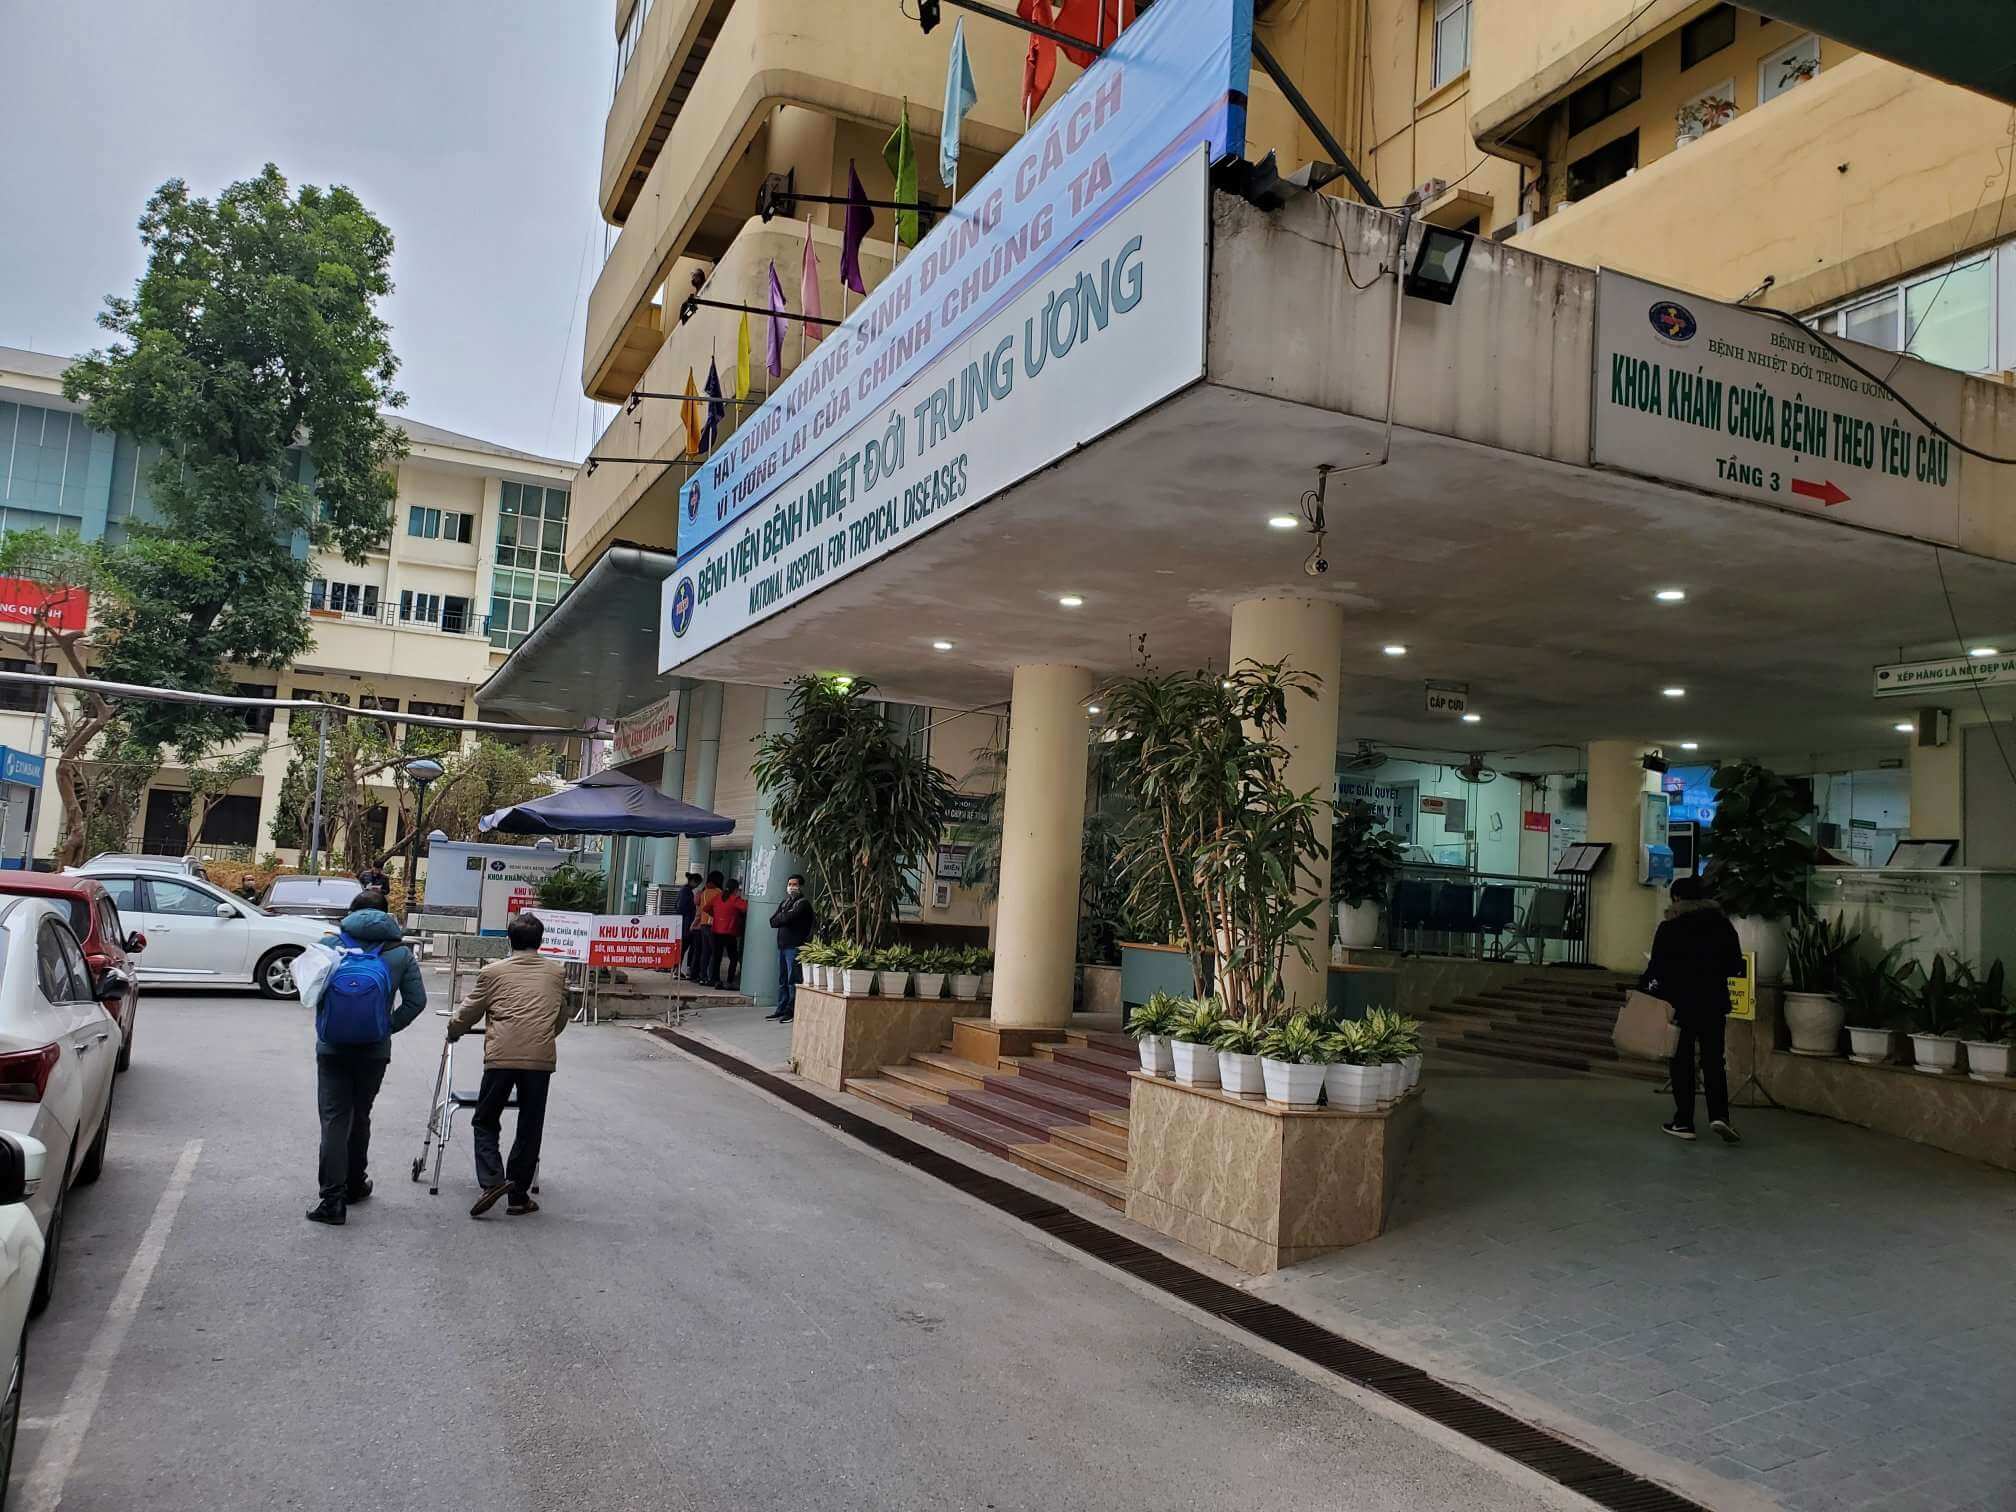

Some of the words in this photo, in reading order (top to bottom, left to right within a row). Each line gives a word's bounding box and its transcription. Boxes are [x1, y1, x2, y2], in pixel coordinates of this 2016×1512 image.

[741, 405, 781, 464] DÙNG
[787, 339, 849, 422] KHÁNG
[856, 276, 912, 355] SINH
[920, 187, 1003, 296] ĐÚNG
[1014, 67, 1124, 204] CÁCH
[718, 489, 729, 521] VÌ
[732, 451, 777, 509] TƯƠNG
[813, 385, 851, 440] CỦA
[858, 311, 932, 401] CHÍNH
[941, 203, 1053, 328] CHÚNG
[1067, 152, 1113, 218] TA
[1816, 368, 1858, 393] TRUNG
[697, 551, 728, 608] BỆNH
[730, 525, 760, 583] VIỆN
[762, 495, 804, 564] BỆNH
[806, 450, 860, 533] NHIỆT
[863, 409, 906, 493] ĐỚI
[914, 334, 1014, 457] TRUNG
[1024, 235, 1143, 379] ƯƠNG
[1612, 353, 1662, 416] KHOA
[1667, 366, 1722, 432] KHÁM
[1727, 381, 1776, 445] CHỮA
[1781, 393, 1827, 463] BỆNH
[1832, 413, 1875, 470] THEO
[1880, 418, 1912, 478] YÊU
[1716, 454, 1763, 488] TẦNG
[1769, 471, 1781, 492] 3
[749, 568, 784, 616] NATIONAL
[786, 542, 825, 594] HOSPITAL
[827, 530, 846, 572] FOR
[848, 496, 899, 559] TROPICAL
[903, 453, 967, 529] DISEASES
[1916, 668, 1943, 680] HÀNG
[1945, 666, 1957, 677] LÀ
[599, 926, 618, 938] KHU
[621, 925, 639, 941] VỰC
[641, 924, 670, 939] KHÁM
